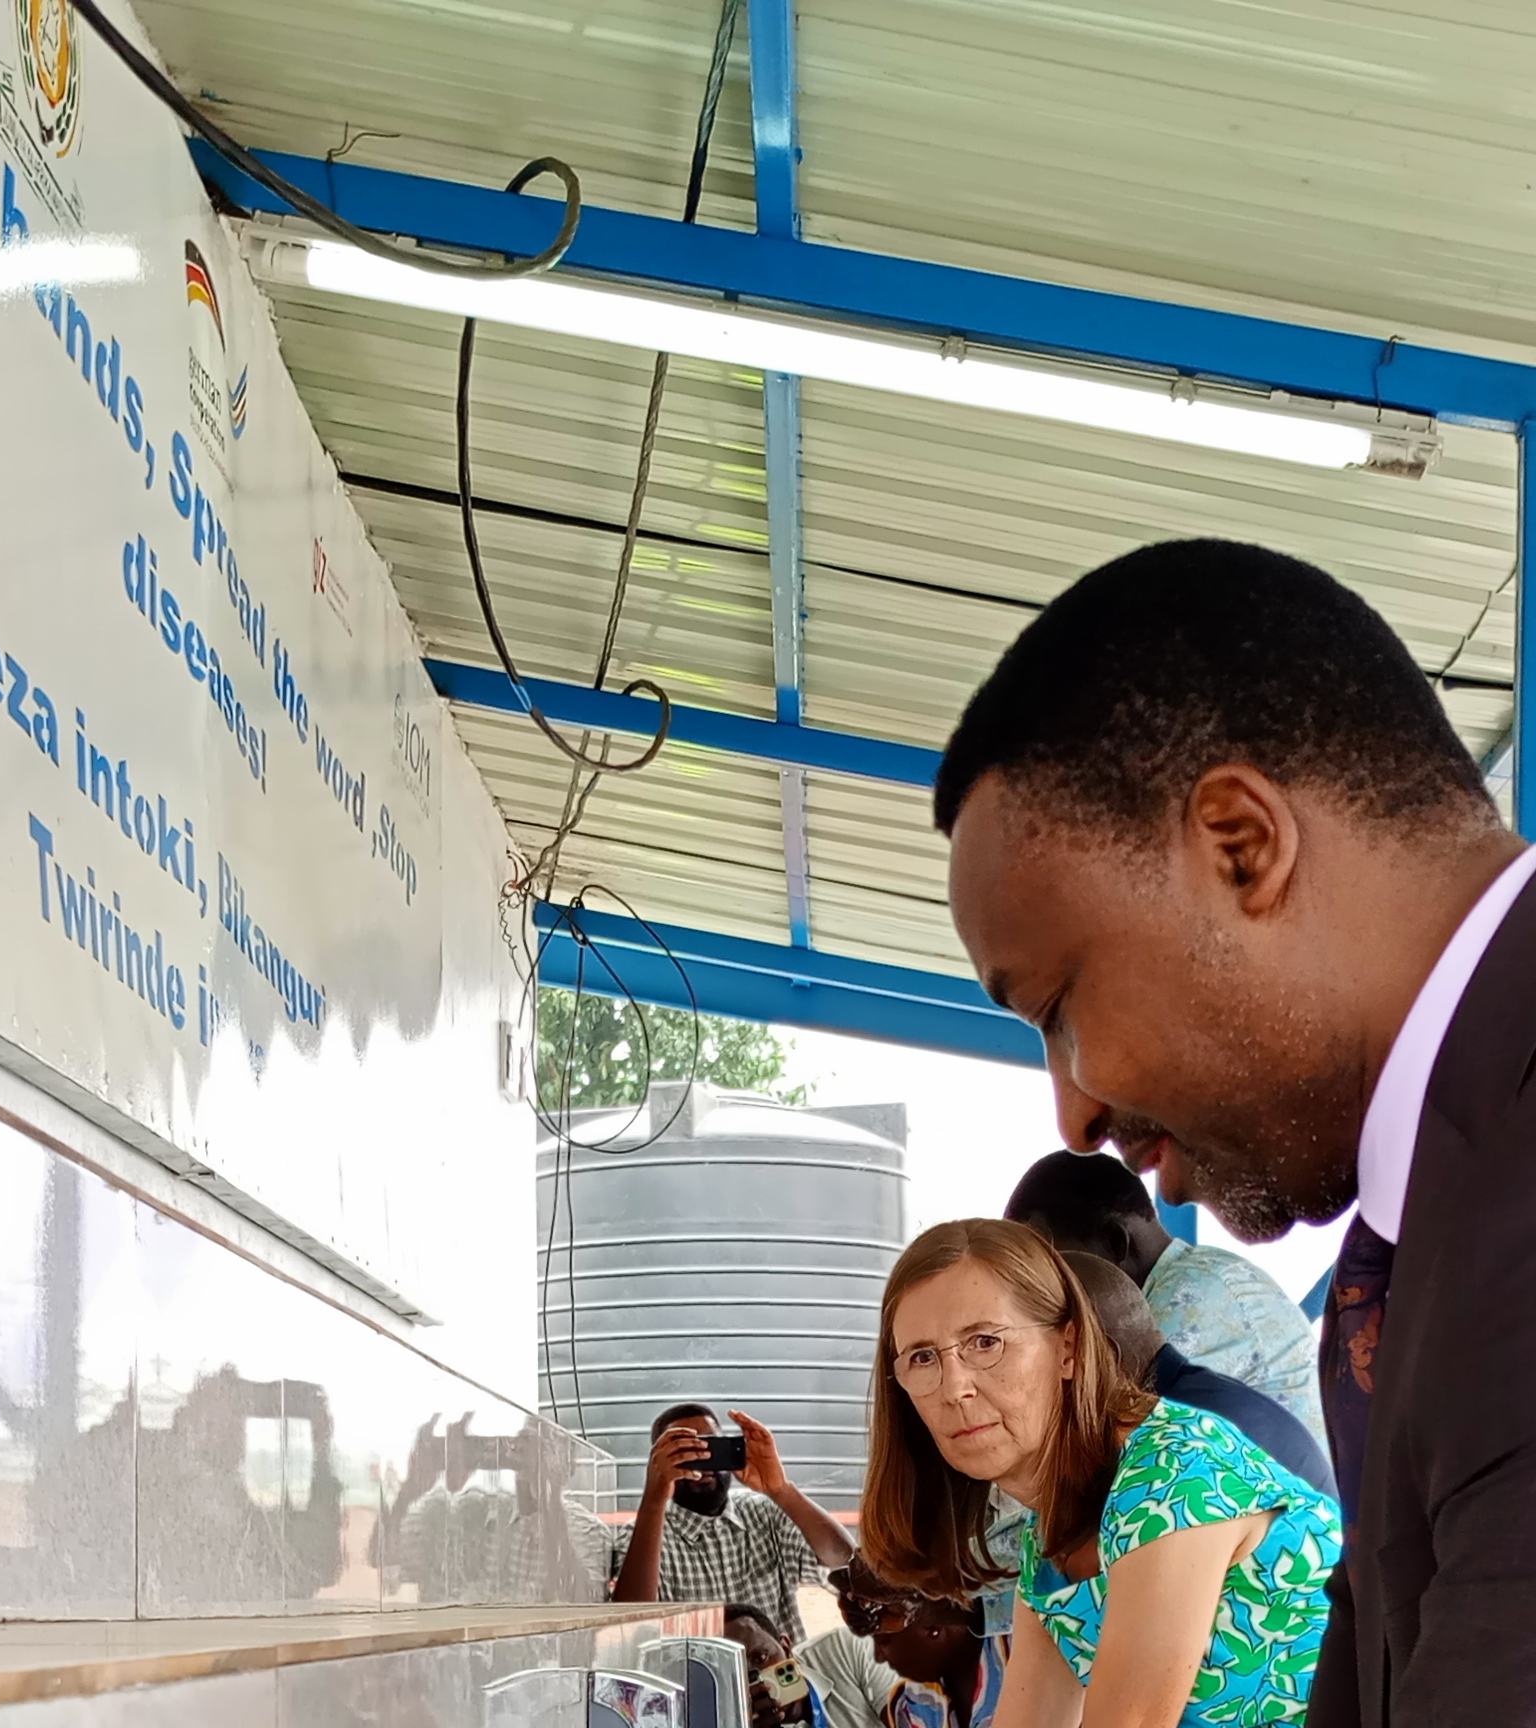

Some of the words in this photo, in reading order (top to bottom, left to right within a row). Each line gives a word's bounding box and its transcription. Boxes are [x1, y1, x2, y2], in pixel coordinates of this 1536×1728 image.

[122, 532, 266, 794] diseases!
[168, 430, 265, 669] Spread
[273, 637, 309, 744] the
[315, 723, 365, 833] word
[75, 706, 207, 919] intoki,
[404, 711, 430, 797] IOM
[28, 811, 186, 1031] Twirinde
